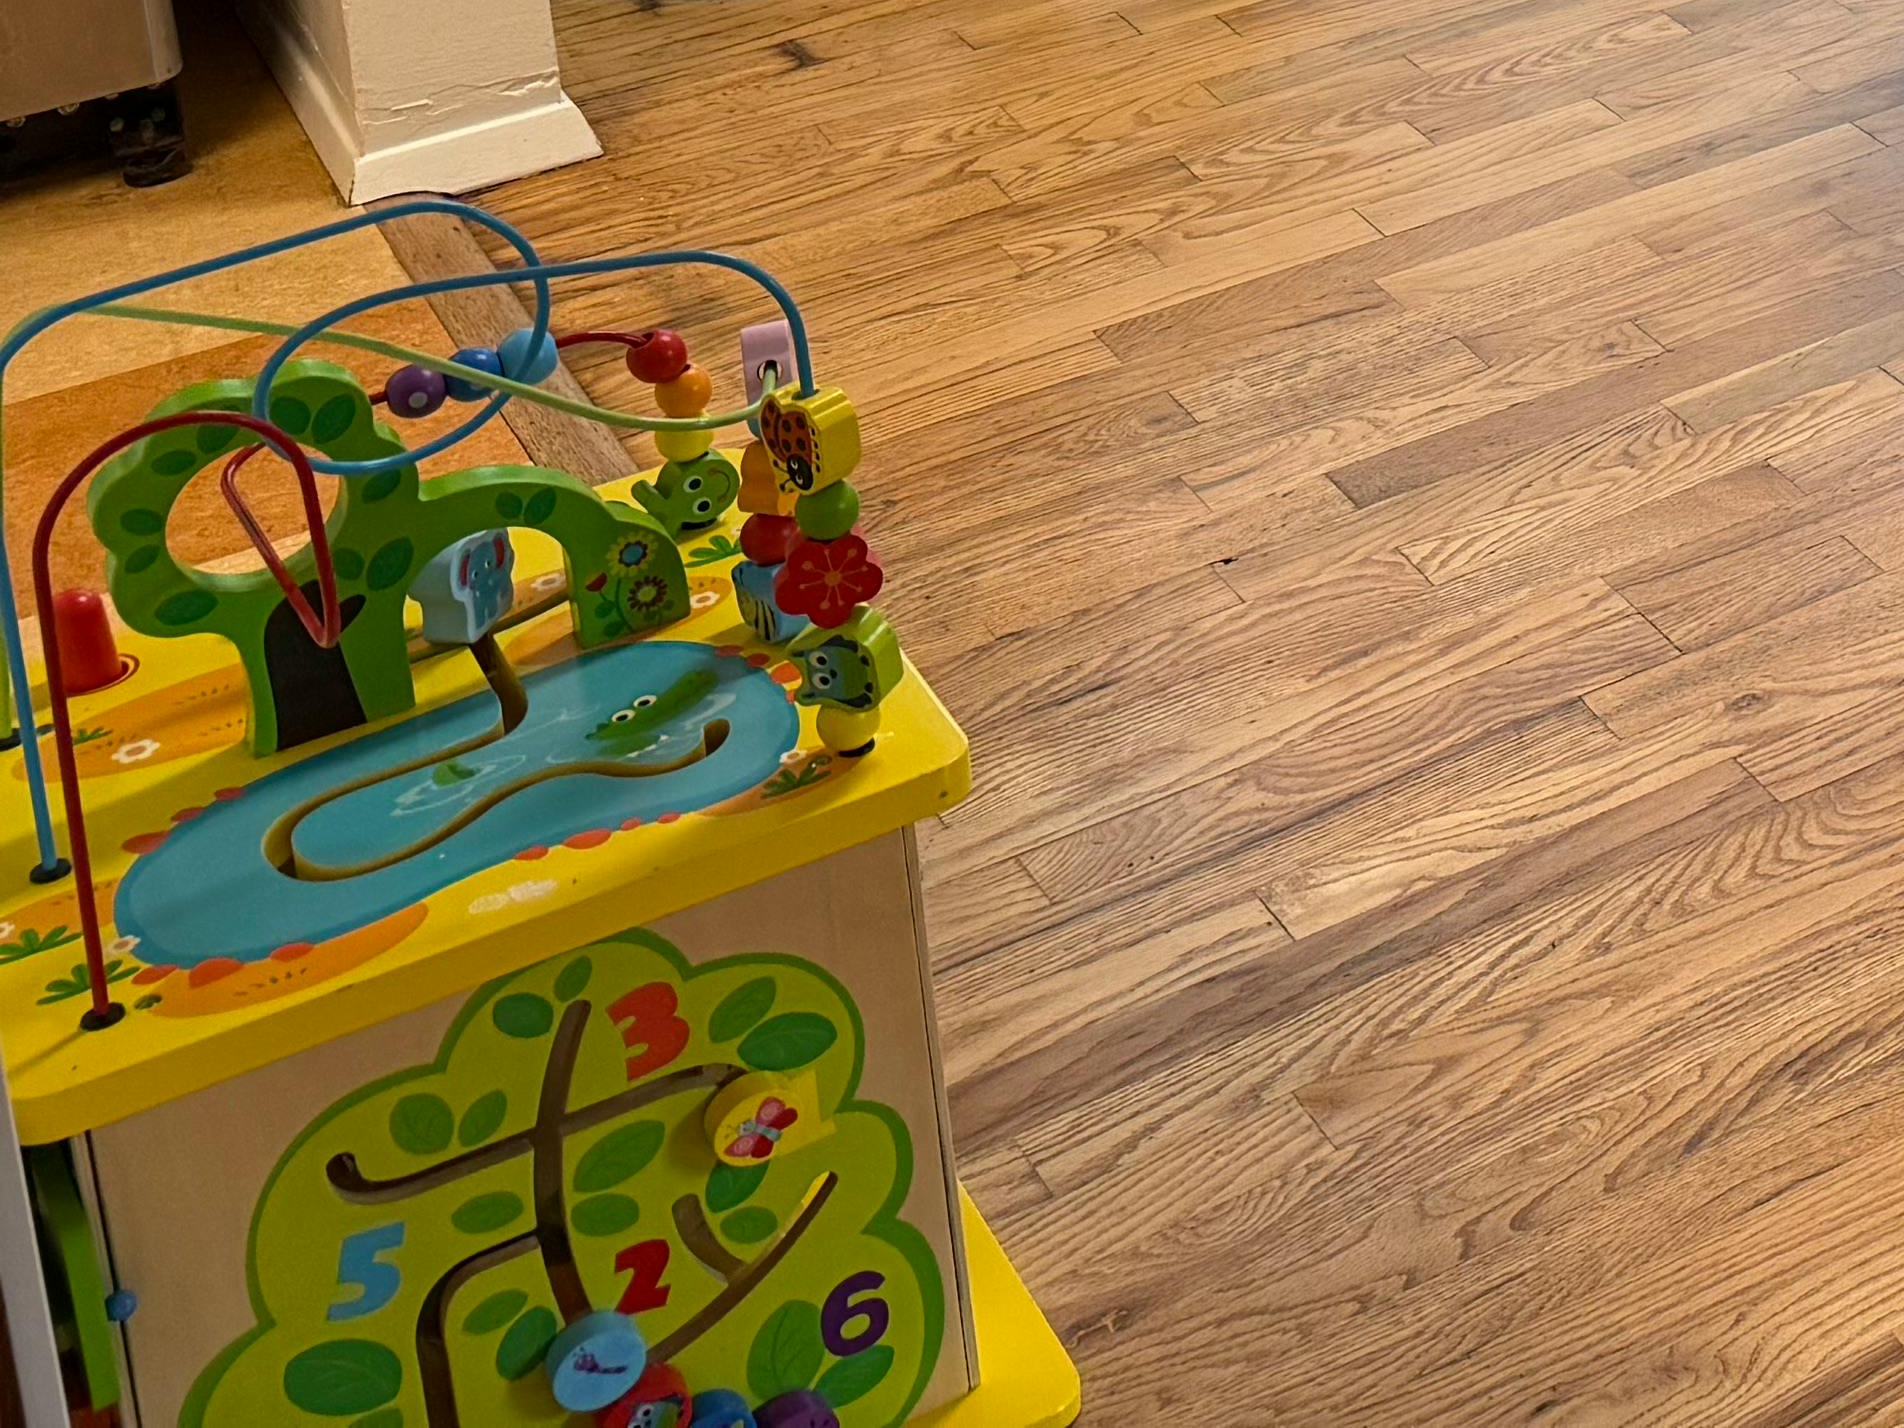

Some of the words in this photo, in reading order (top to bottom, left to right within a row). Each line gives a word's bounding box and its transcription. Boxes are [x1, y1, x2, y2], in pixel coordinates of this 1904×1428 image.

[606, 981, 691, 1080] 3
[327, 1220, 404, 1320] 5
[614, 1238, 672, 1315] 2
[820, 1270, 889, 1357] 6
